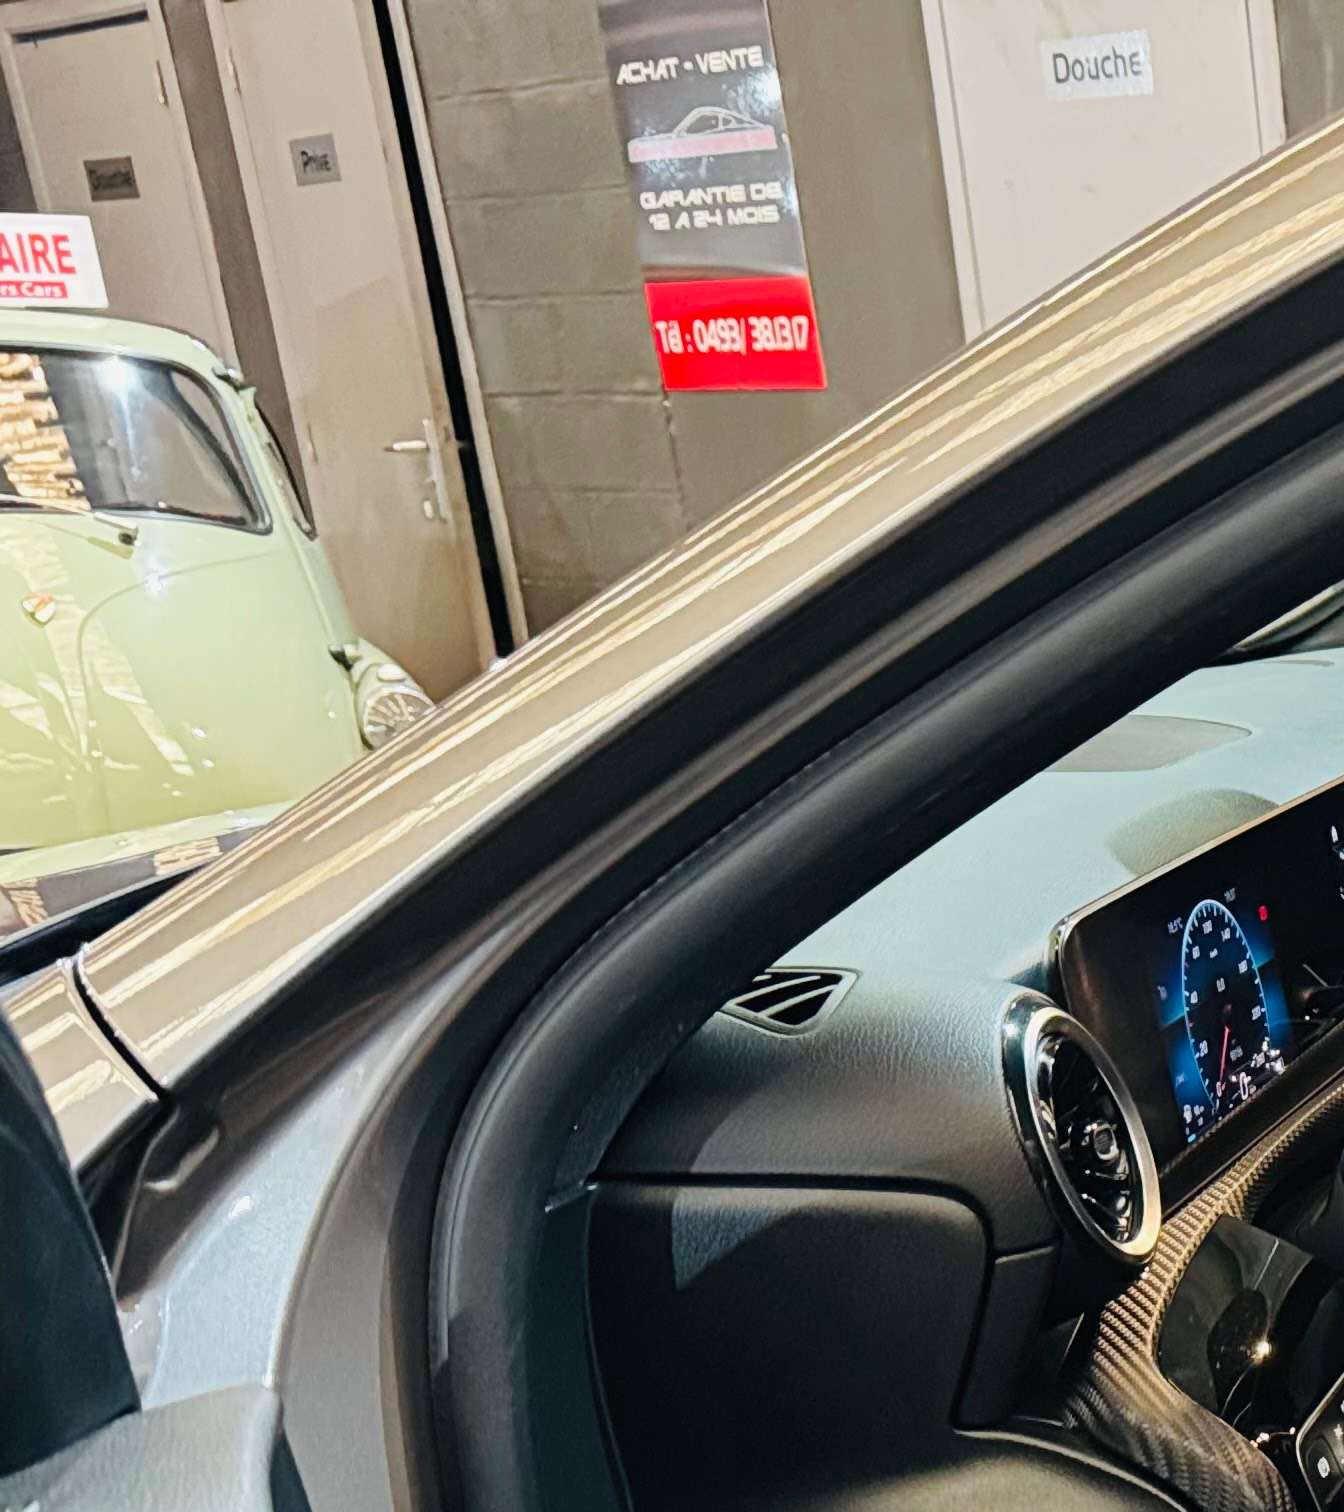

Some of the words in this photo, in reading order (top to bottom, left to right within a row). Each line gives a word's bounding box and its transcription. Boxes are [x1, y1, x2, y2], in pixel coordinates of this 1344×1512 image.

[616, 56, 680, 85] ACHAT
[695, 45, 764, 75] VENTE
[1053, 45, 1143, 84] Douche
[639, 184, 747, 210] GARANTIE
[750, 181, 784, 201] DE
[648, 212, 671, 231] 12
[692, 208, 723, 228] 24
[727, 204, 781, 225] MOIS
[0, 232, 77, 274] AIRE
